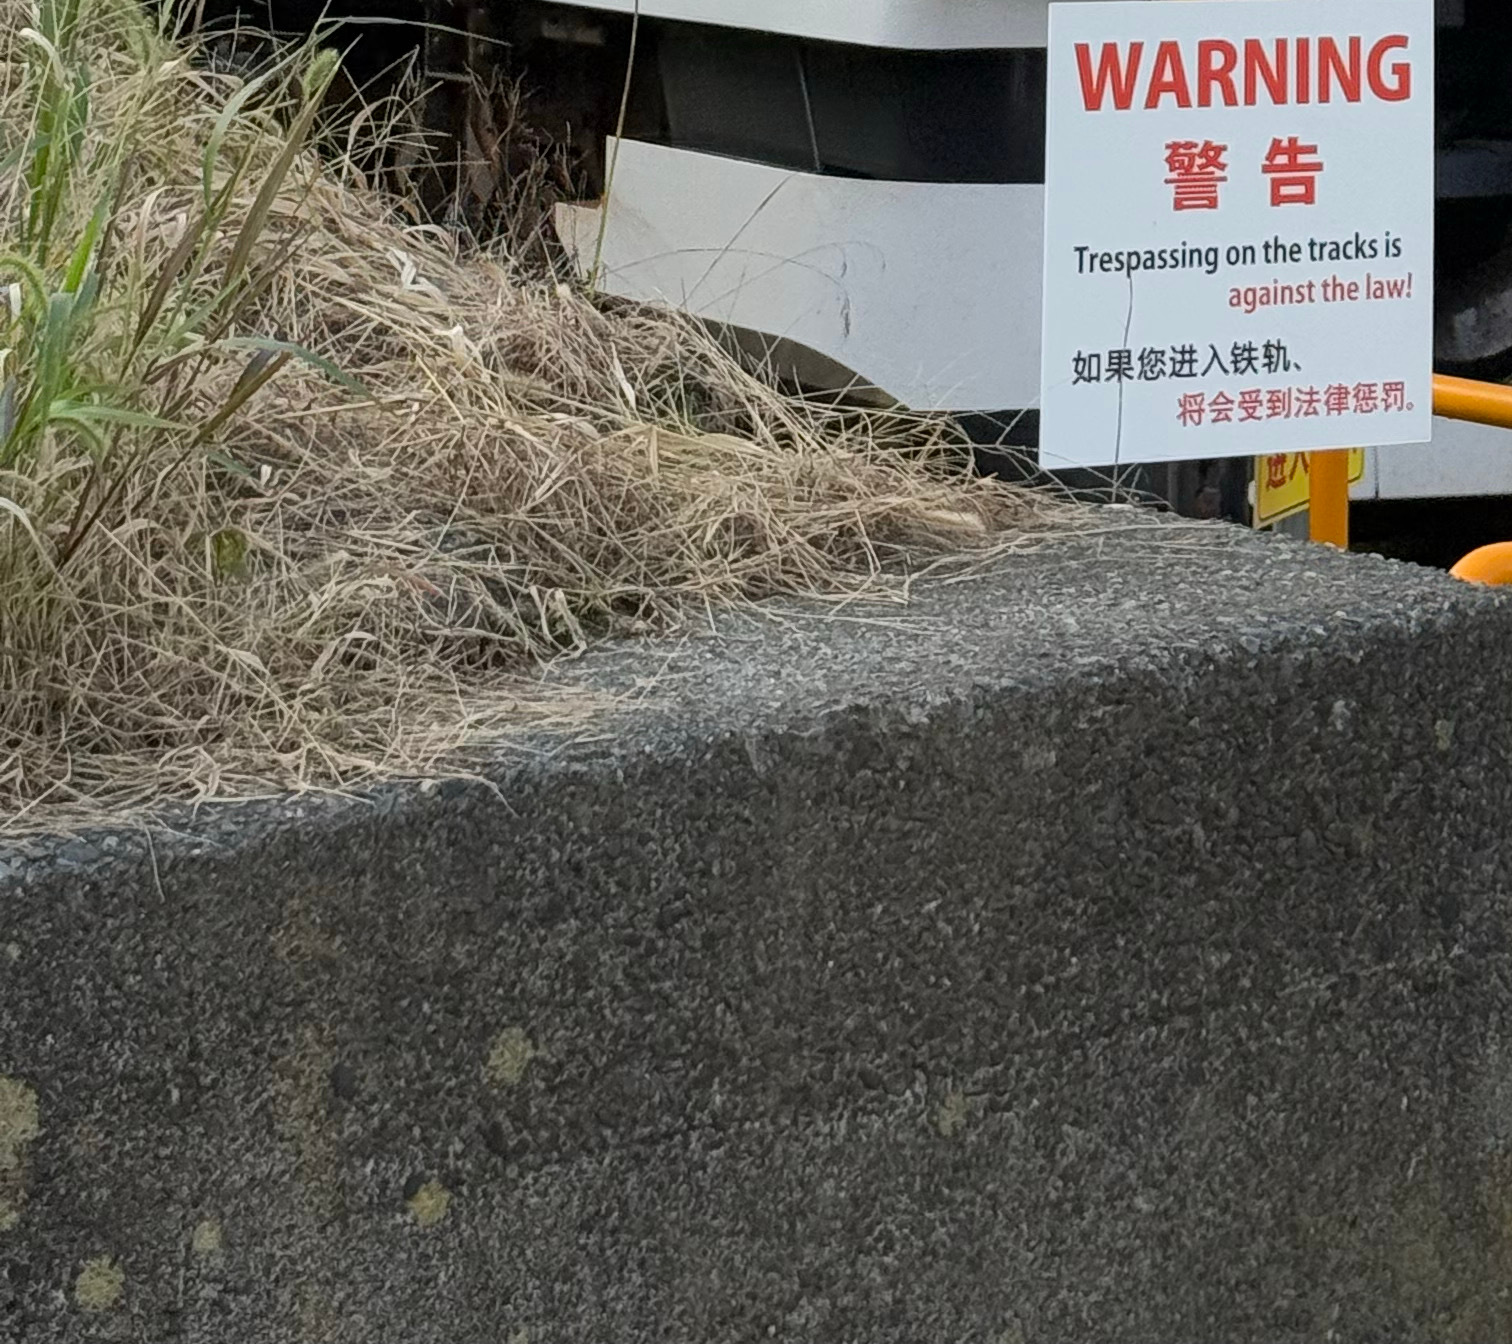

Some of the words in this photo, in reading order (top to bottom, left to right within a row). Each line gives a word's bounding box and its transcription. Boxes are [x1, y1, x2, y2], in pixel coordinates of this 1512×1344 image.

[1074, 34, 1412, 111] WARNING
[1164, 136, 1323, 211] 警告
[1074, 240, 1219, 279] Trespassing
[1226, 243, 1256, 266] on
[1262, 234, 1302, 264] the
[1307, 231, 1379, 262] tracks
[1385, 231, 1402, 258] is
[1228, 278, 1315, 313] against
[1321, 274, 1359, 303] the
[1365, 272, 1413, 300] law!
[1072, 339, 1302, 385] 如果您进入铁轨、
[1177, 381, 1414, 426] 将会受到法律惩罚。
